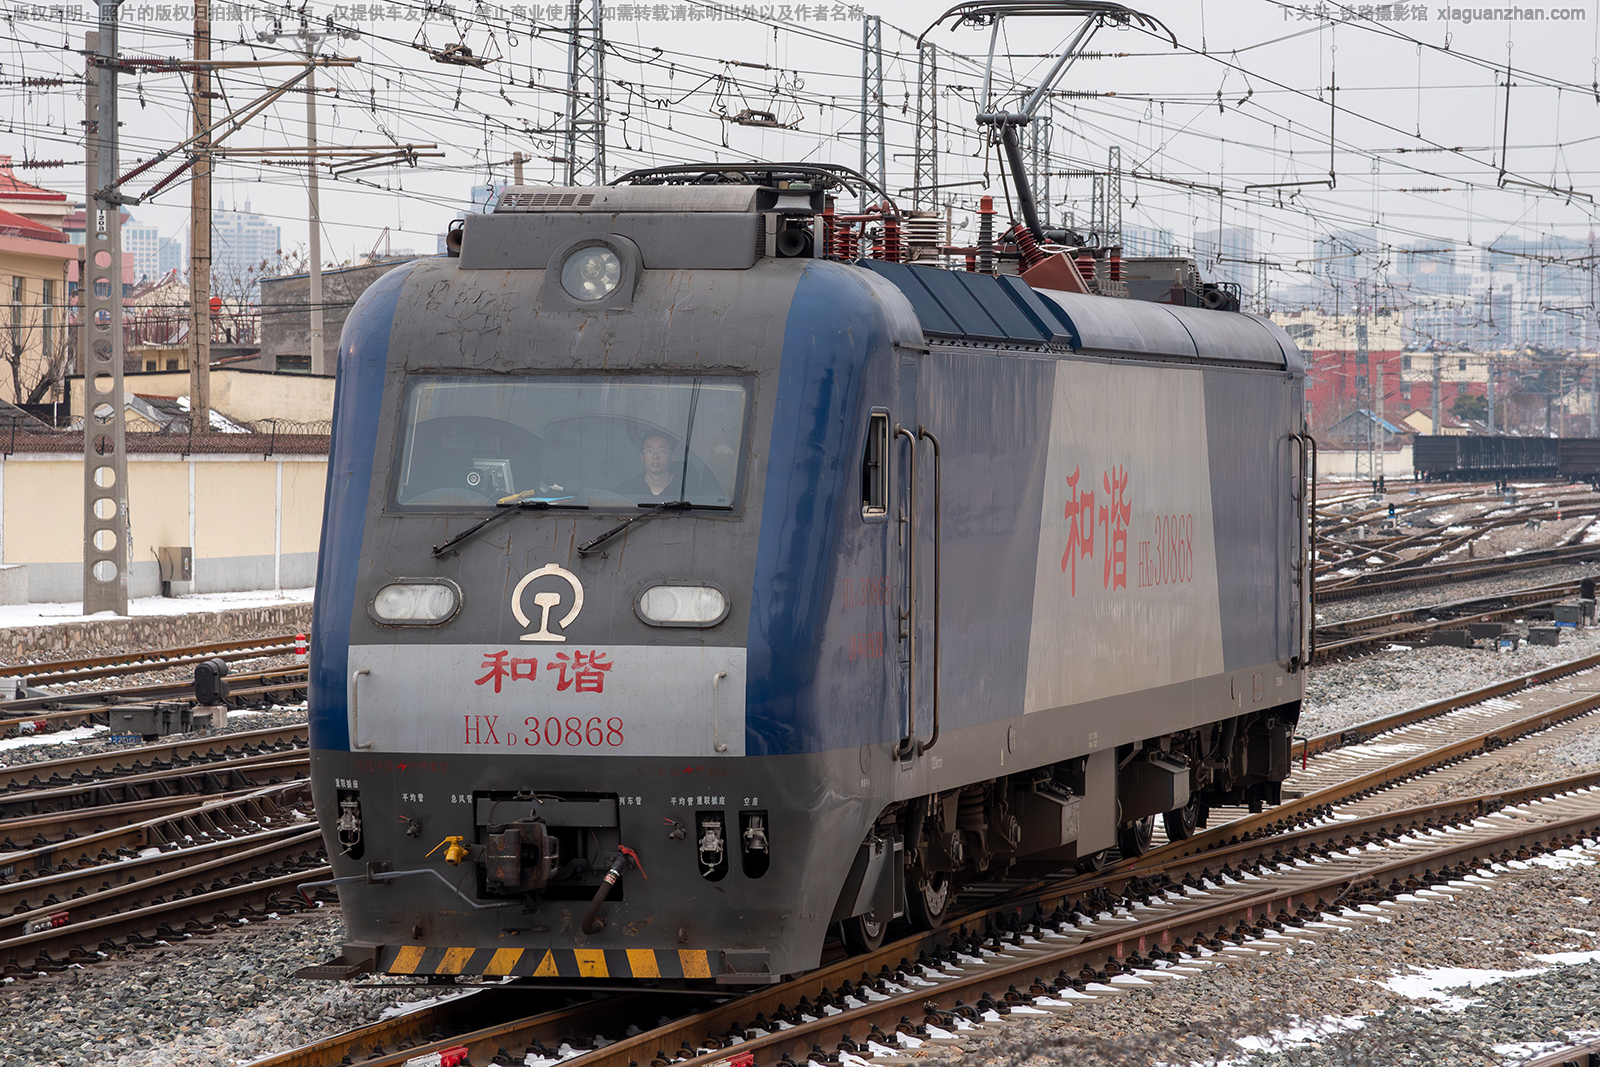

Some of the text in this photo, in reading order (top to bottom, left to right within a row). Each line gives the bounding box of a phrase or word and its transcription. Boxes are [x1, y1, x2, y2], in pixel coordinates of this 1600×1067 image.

[1061, 463, 1132, 598] 和谐
[474, 649, 614, 694] 和谐
[402, 793, 424, 803] 平均管
[451, 794, 473, 804] 总风管
[670, 796, 694, 806] 平均管
[696, 795, 726, 805] 重联插座
